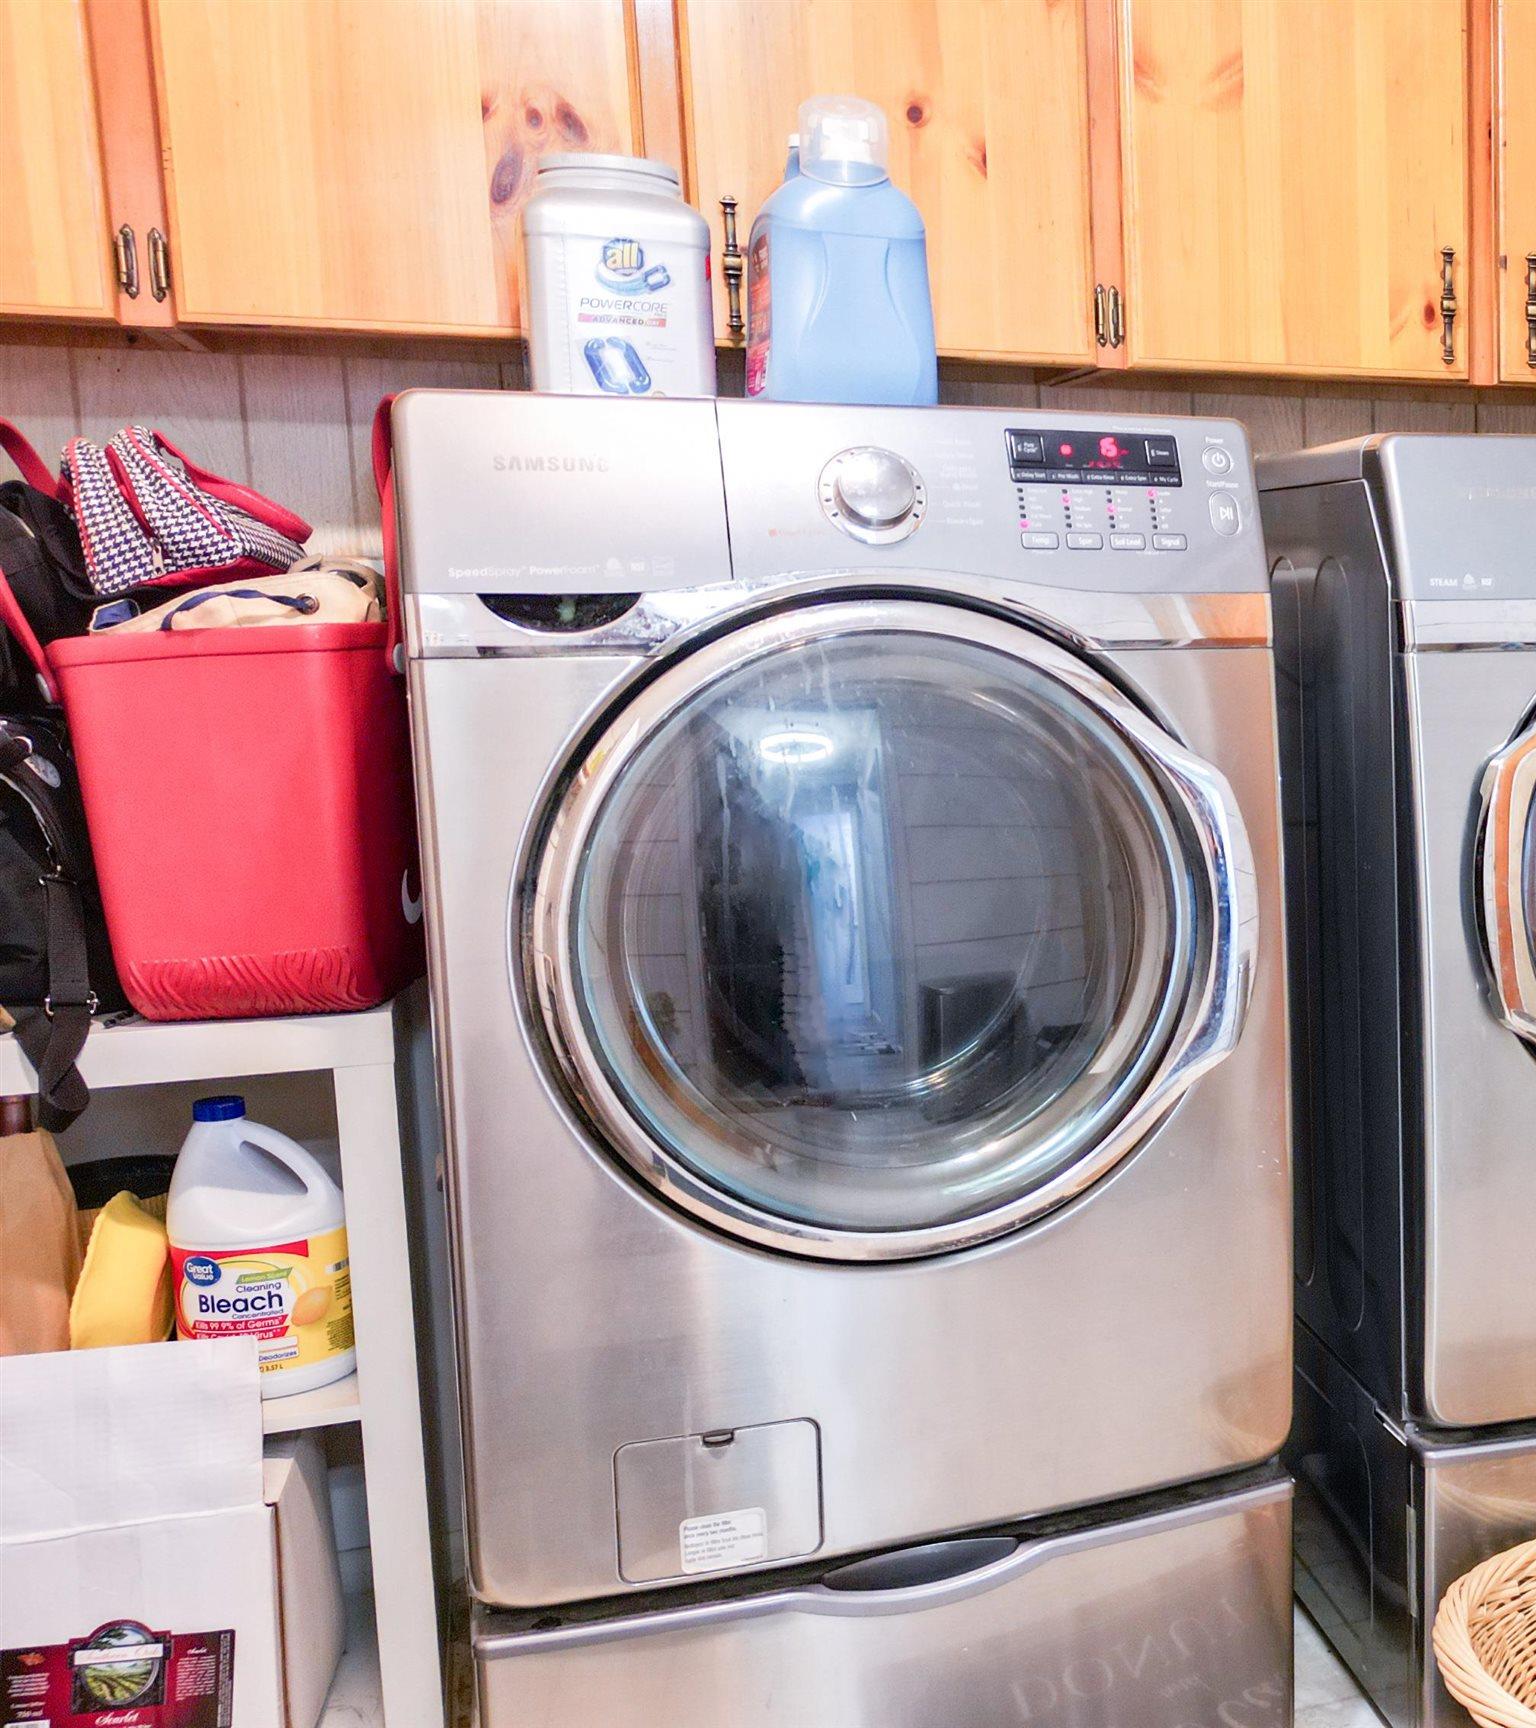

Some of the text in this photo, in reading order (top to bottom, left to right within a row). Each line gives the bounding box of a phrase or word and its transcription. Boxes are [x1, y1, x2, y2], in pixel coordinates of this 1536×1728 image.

[606, 242, 639, 270] all
[580, 297, 669, 313] POWERCORE
[592, 315, 645, 326] ADVANCED
[492, 454, 610, 473] SAMSUNG
[1429, 577, 1458, 587] STEAM
[186, 1262, 213, 1274] Great
[193, 1272, 214, 1281] Value
[235, 1282, 282, 1294] Cleaning
[198, 1290, 284, 1313] Bleach
[231, 1309, 284, 1320] Concentrated
[236, 1320, 246, 1329] of
